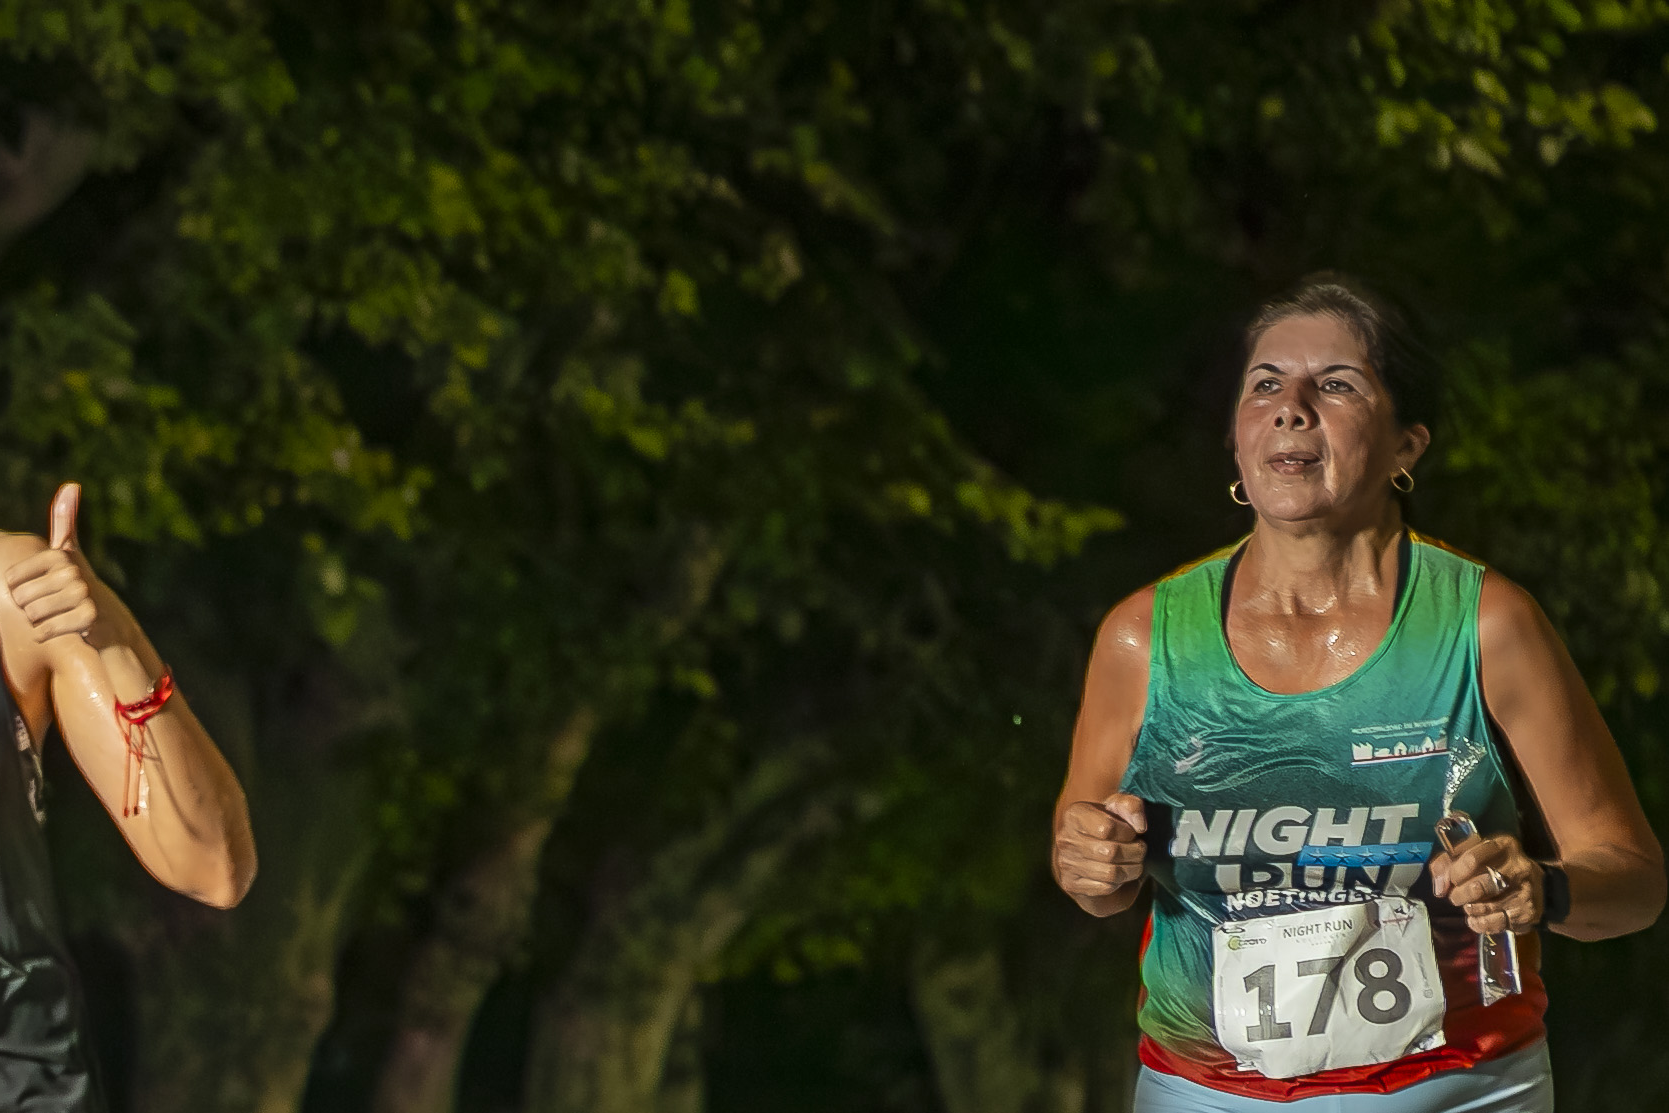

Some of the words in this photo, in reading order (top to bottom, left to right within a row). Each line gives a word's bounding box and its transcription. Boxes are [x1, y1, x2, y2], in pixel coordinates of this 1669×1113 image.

[1170, 803, 1420, 858] NIGHT
[1282, 922, 1321, 939] NIGHT
[1324, 918, 1354, 933] RUN
[1243, 947, 1412, 1043] 178
